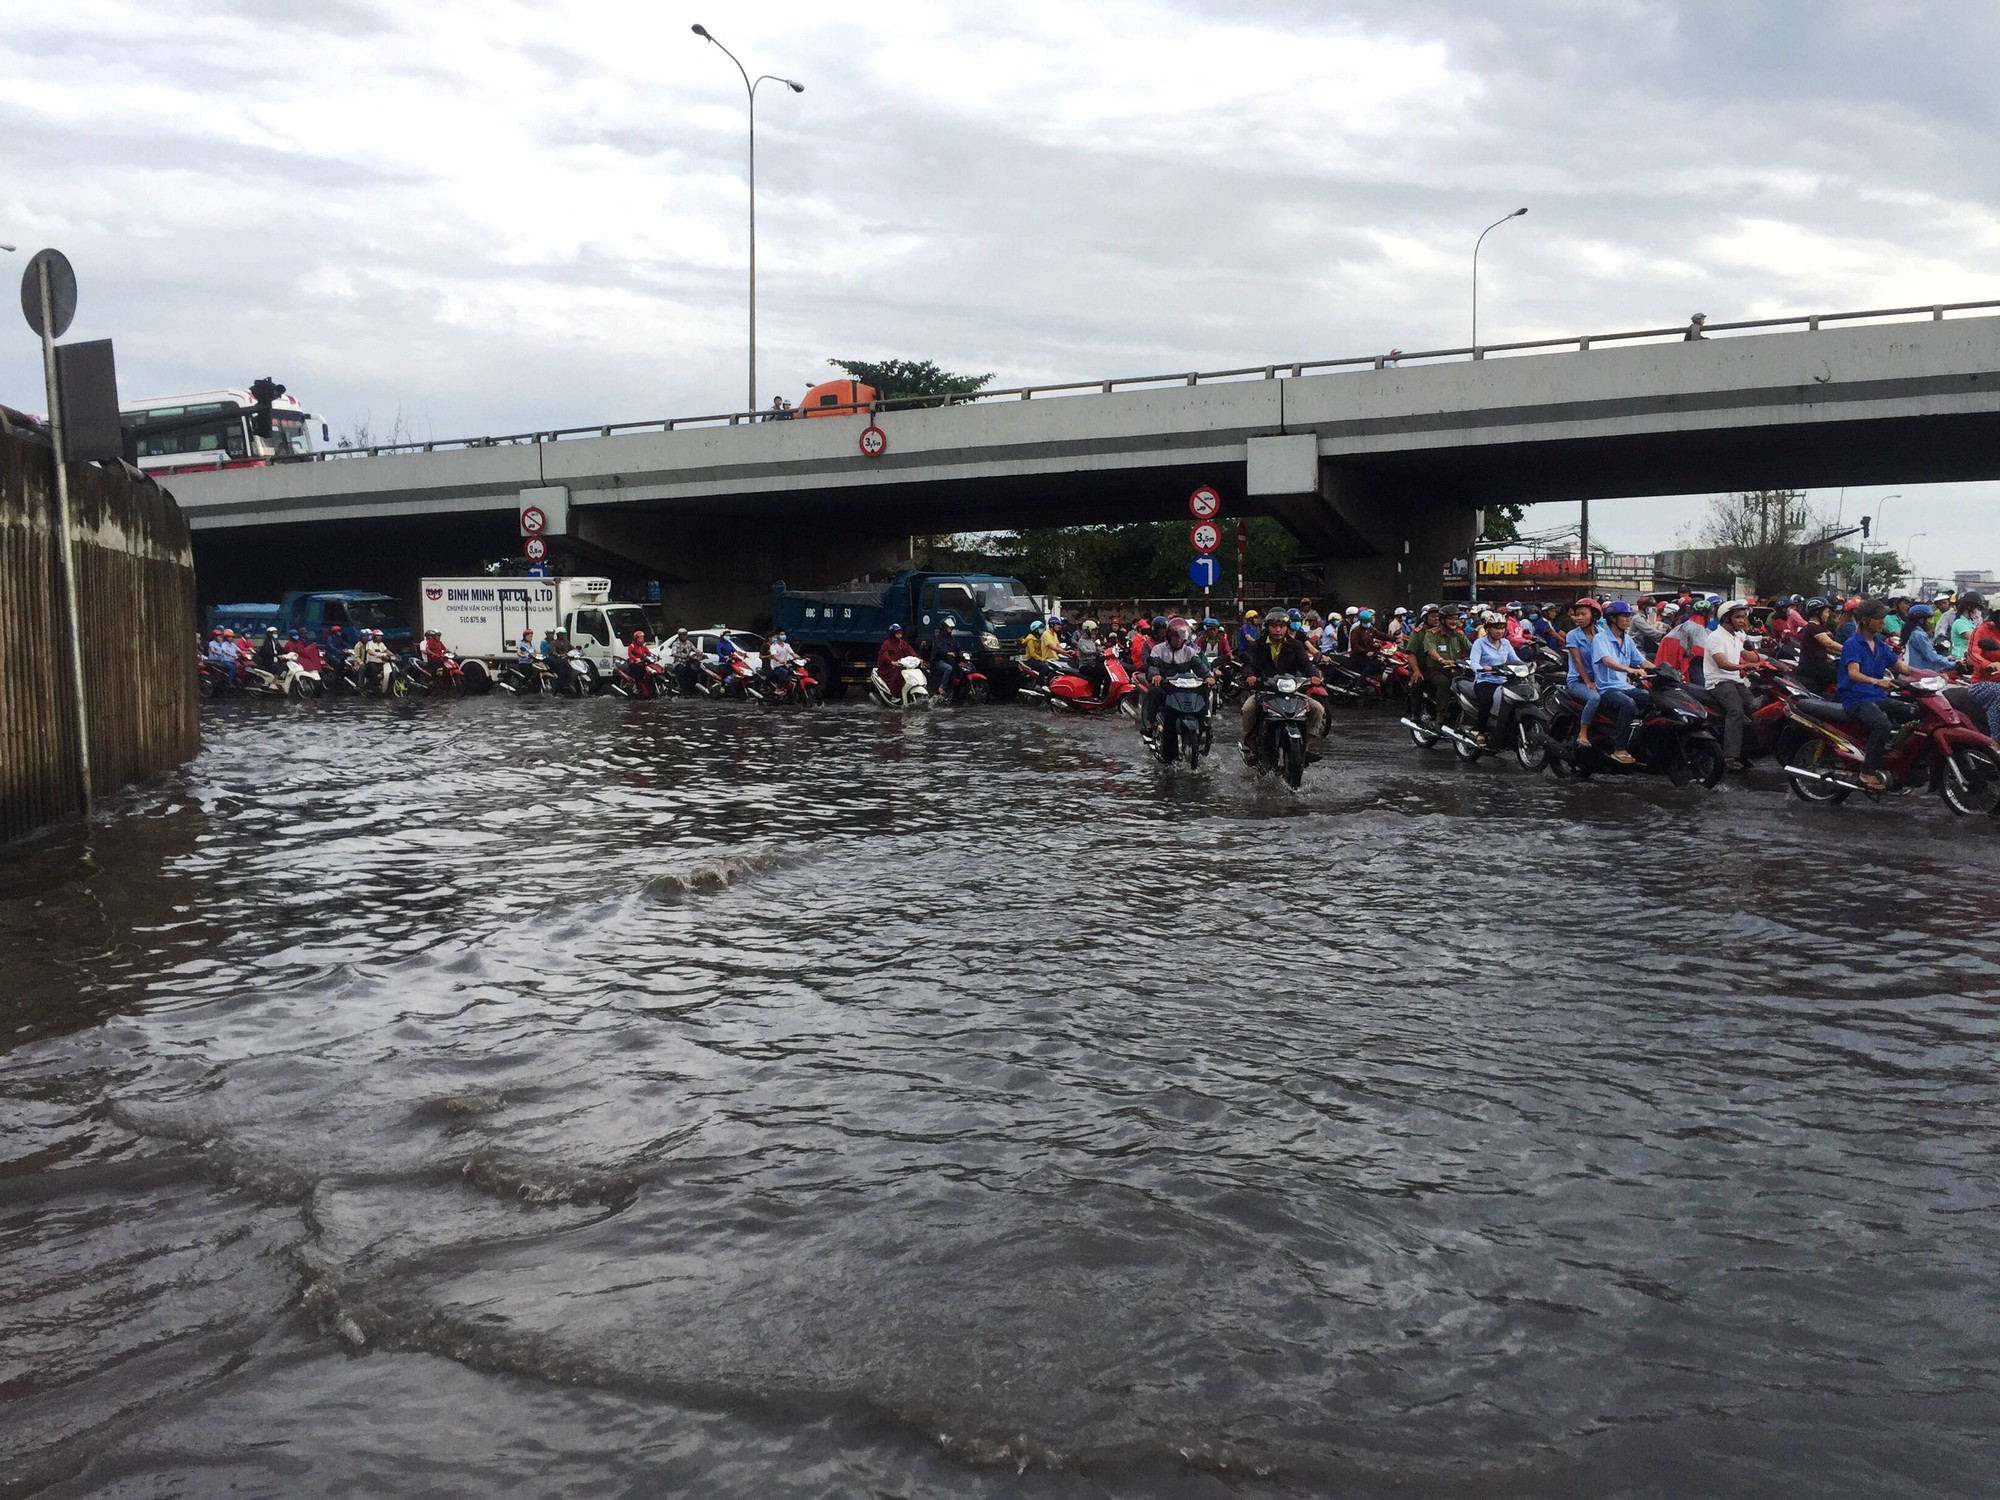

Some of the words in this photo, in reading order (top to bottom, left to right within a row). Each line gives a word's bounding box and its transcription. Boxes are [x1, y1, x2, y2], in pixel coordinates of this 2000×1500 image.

[448, 589, 469, 601] BINH
[471, 589, 494, 601] MINH
[535, 589, 553, 602] LTD
